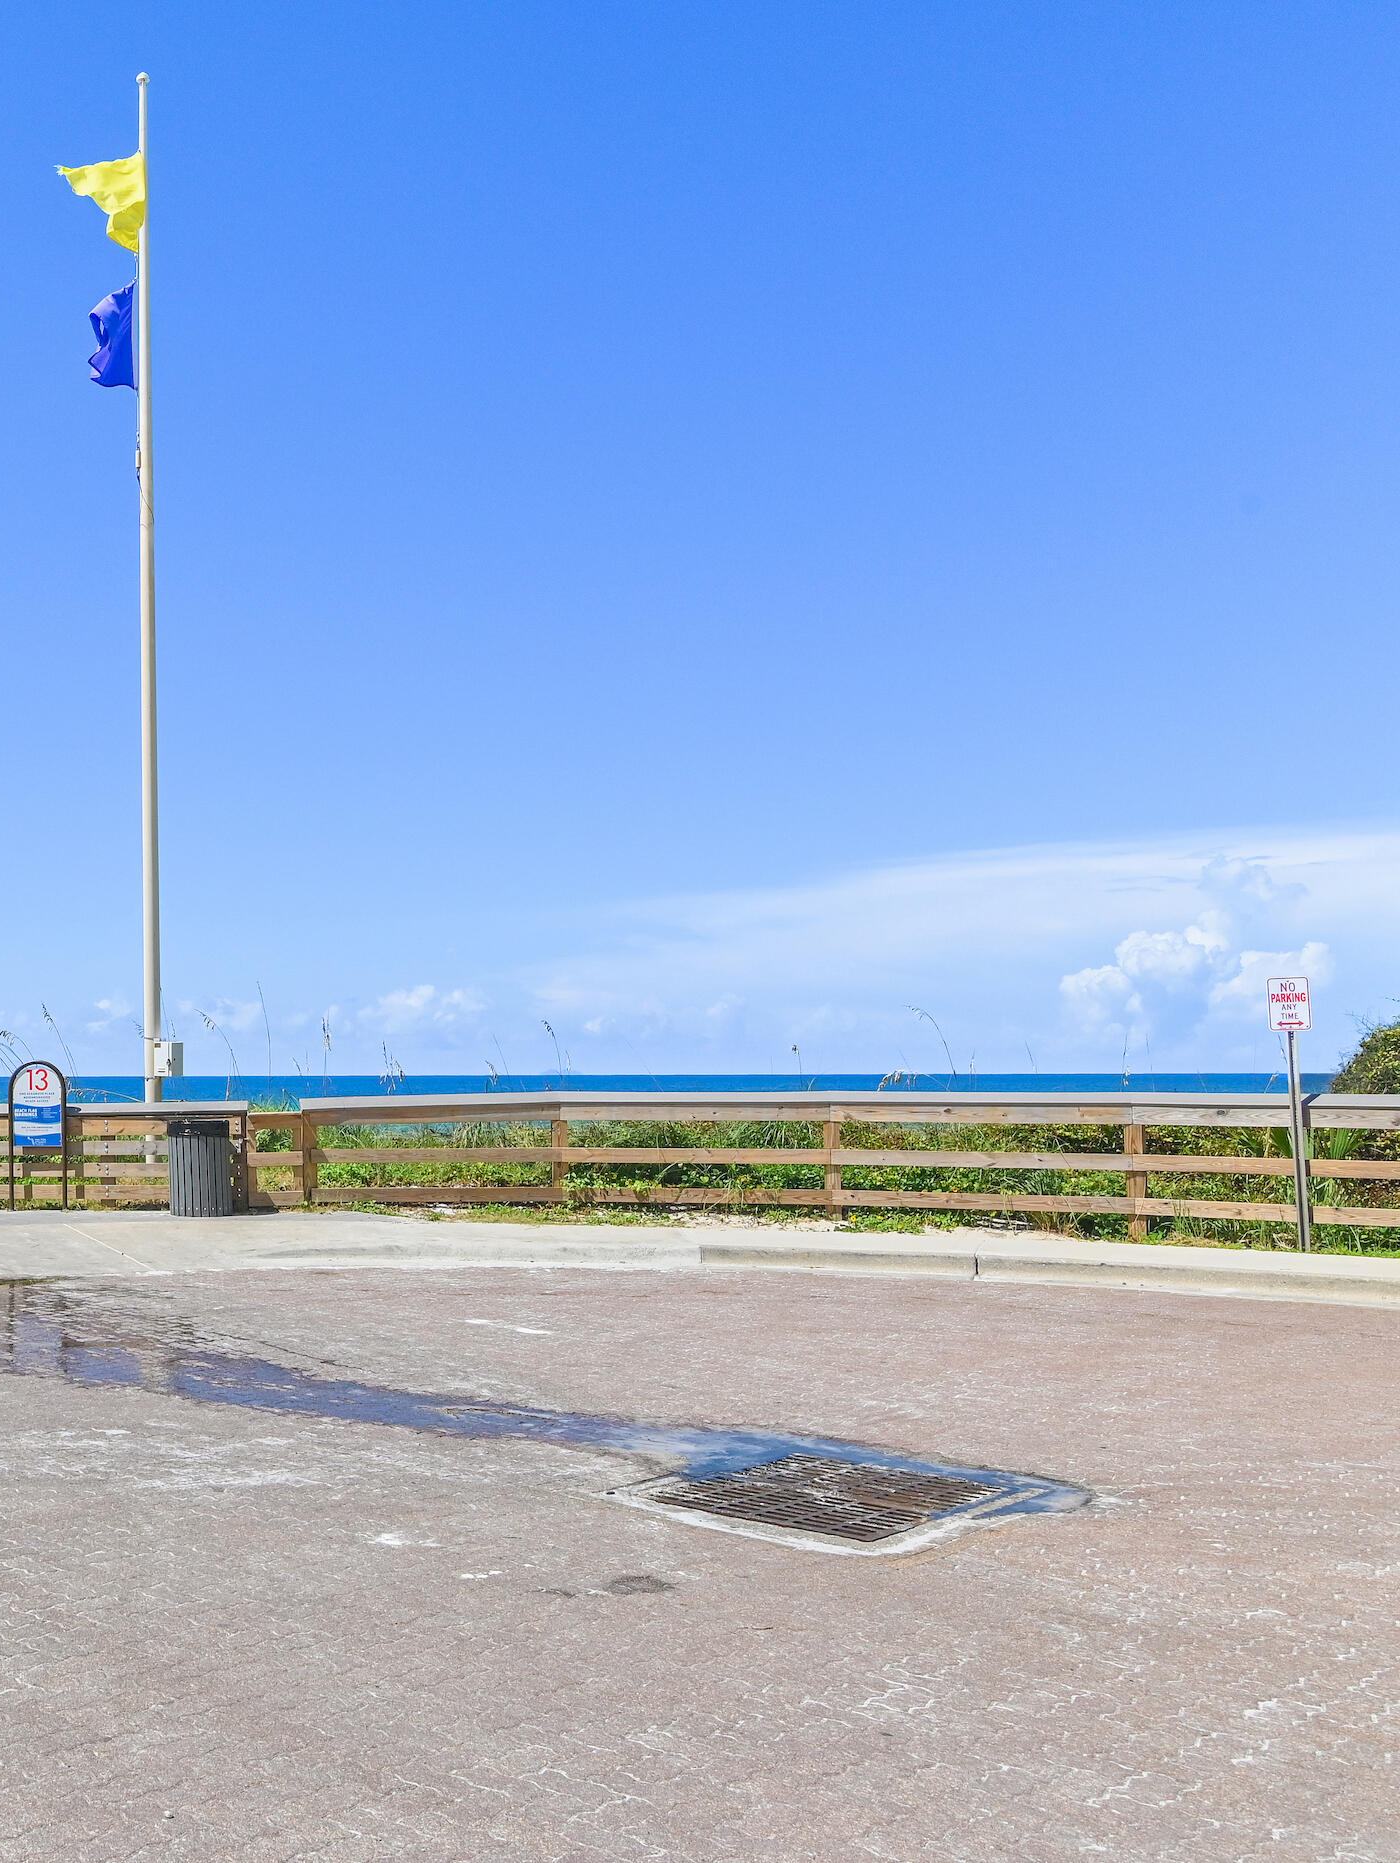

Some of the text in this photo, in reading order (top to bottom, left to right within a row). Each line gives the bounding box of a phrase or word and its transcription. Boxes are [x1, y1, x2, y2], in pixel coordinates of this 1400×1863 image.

[1280, 982, 1295, 992] NO
[1271, 992, 1306, 1003] PARKING
[26, 1069, 48, 1091] 13
